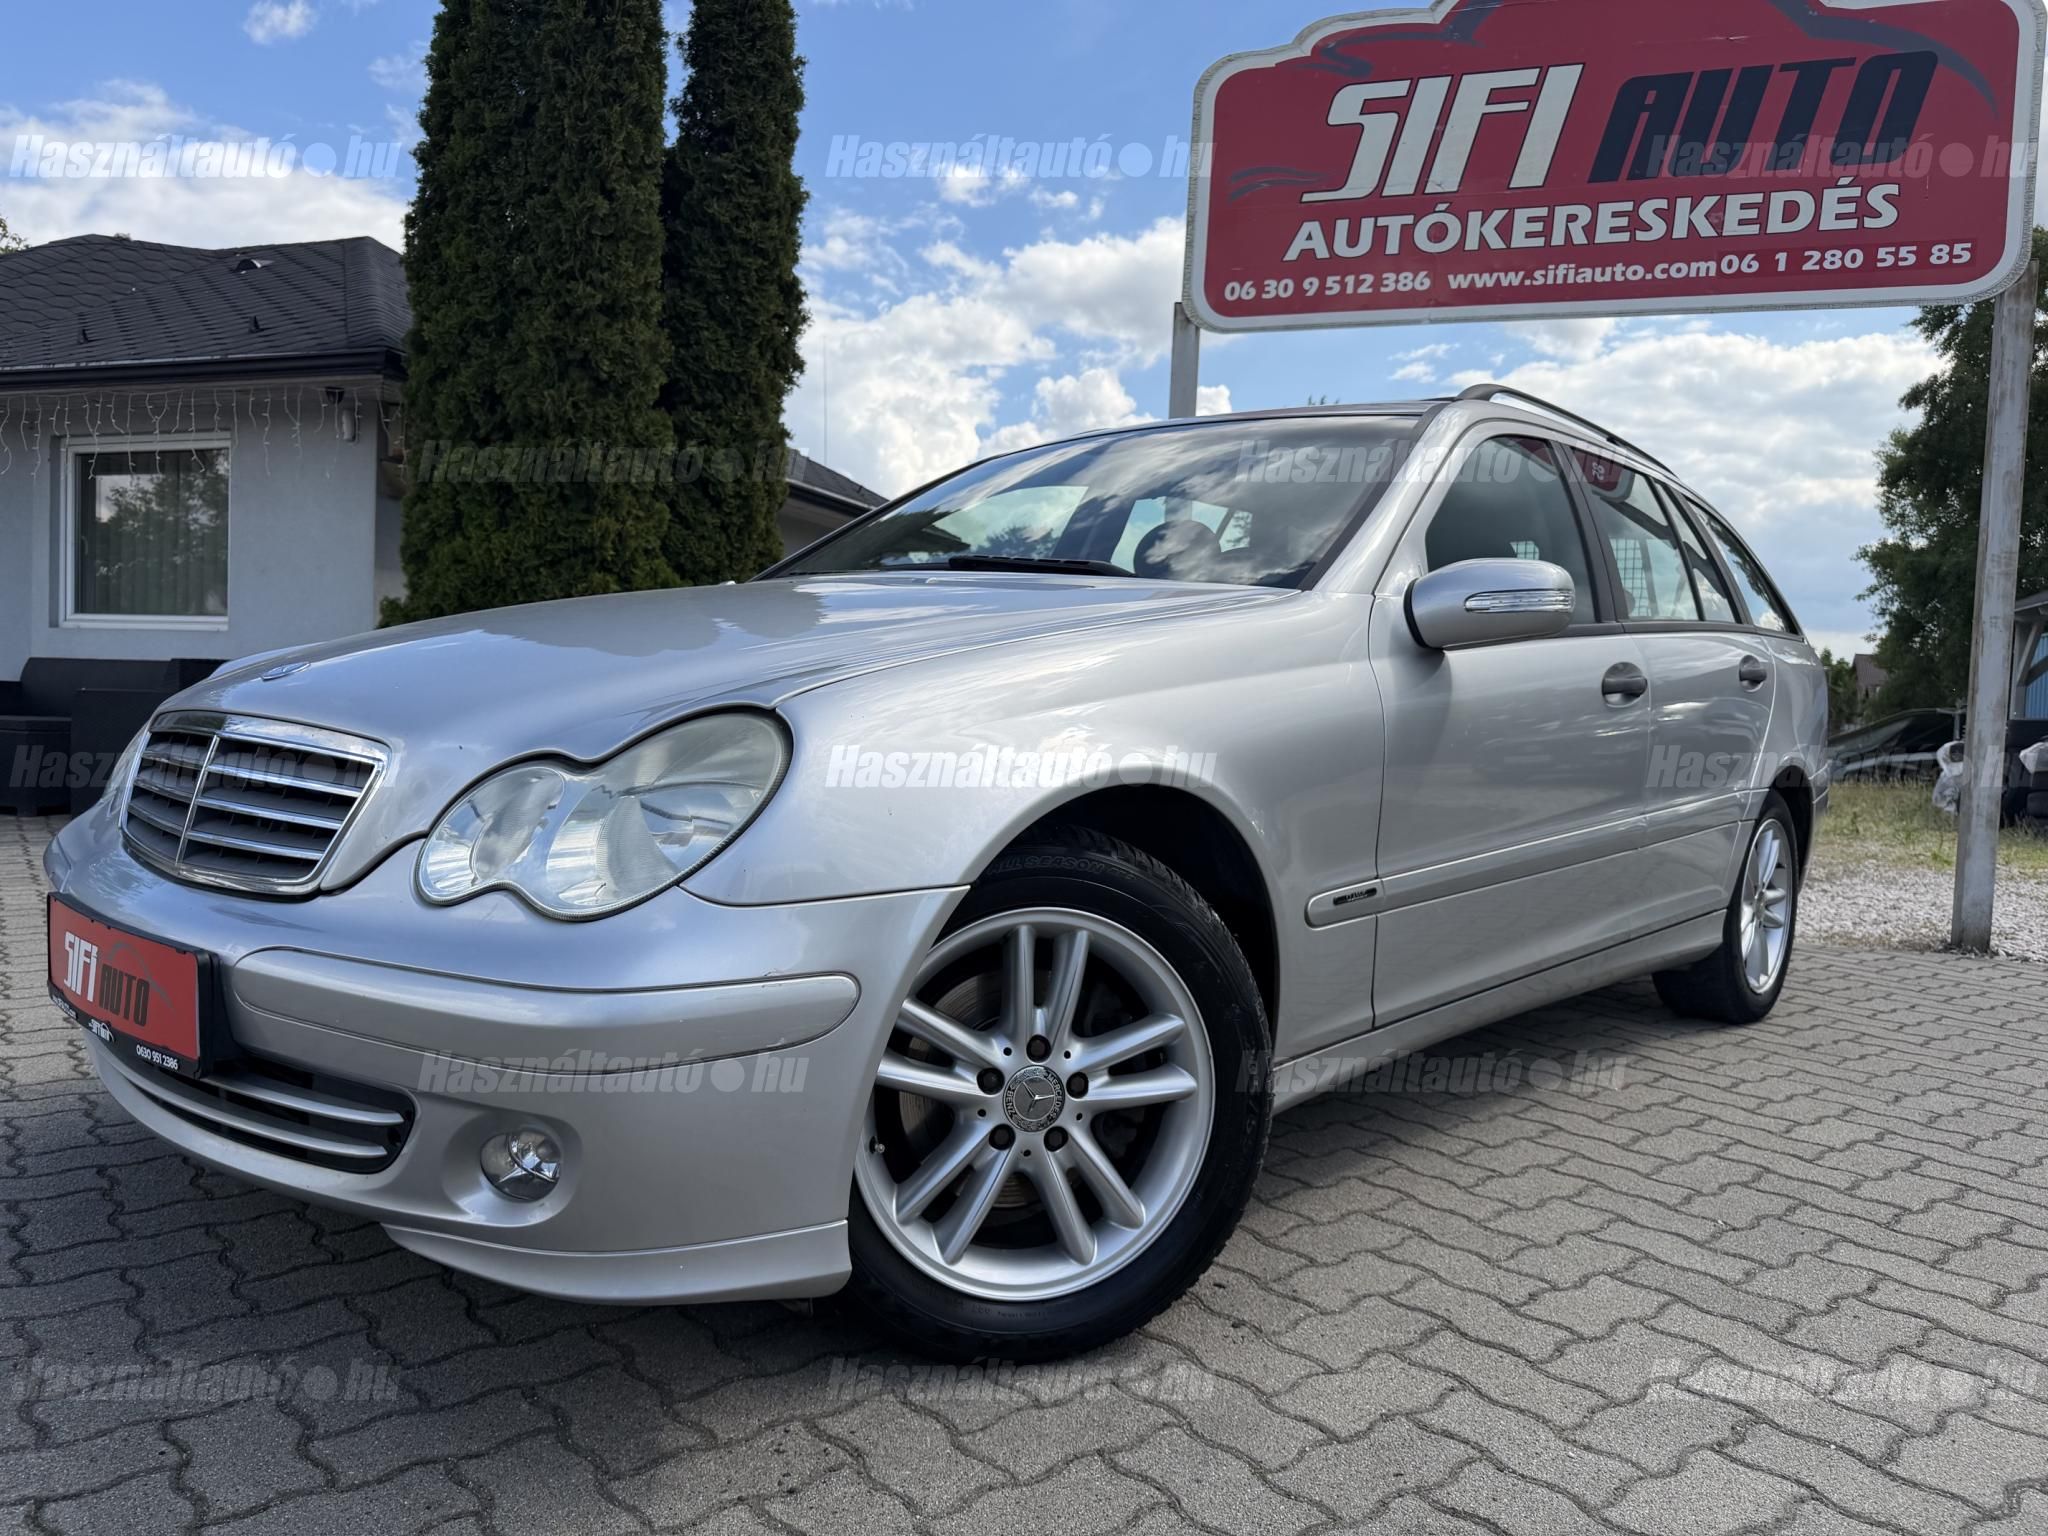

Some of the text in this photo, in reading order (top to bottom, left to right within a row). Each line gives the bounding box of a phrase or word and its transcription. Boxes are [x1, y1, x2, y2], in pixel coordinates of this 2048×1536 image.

[1300, 50, 1939, 204] SIFI AUTO
[1283, 176, 1901, 262] AUTÓKERESKEDÉS
[1224, 281, 1256, 301] 06
[1261, 278, 1294, 299] 30
[1380, 271, 1431, 293] 386
[1448, 258, 1716, 289] www.sifiauto.com
[1721, 253, 1760, 274] 06
[1775, 252, 1787, 272] 1
[1801, 248, 1863, 271] 280
[1876, 246, 1917, 267] 55
[1929, 242, 1972, 265] 85
[64, 931, 149, 1027] SIFI AUTO
